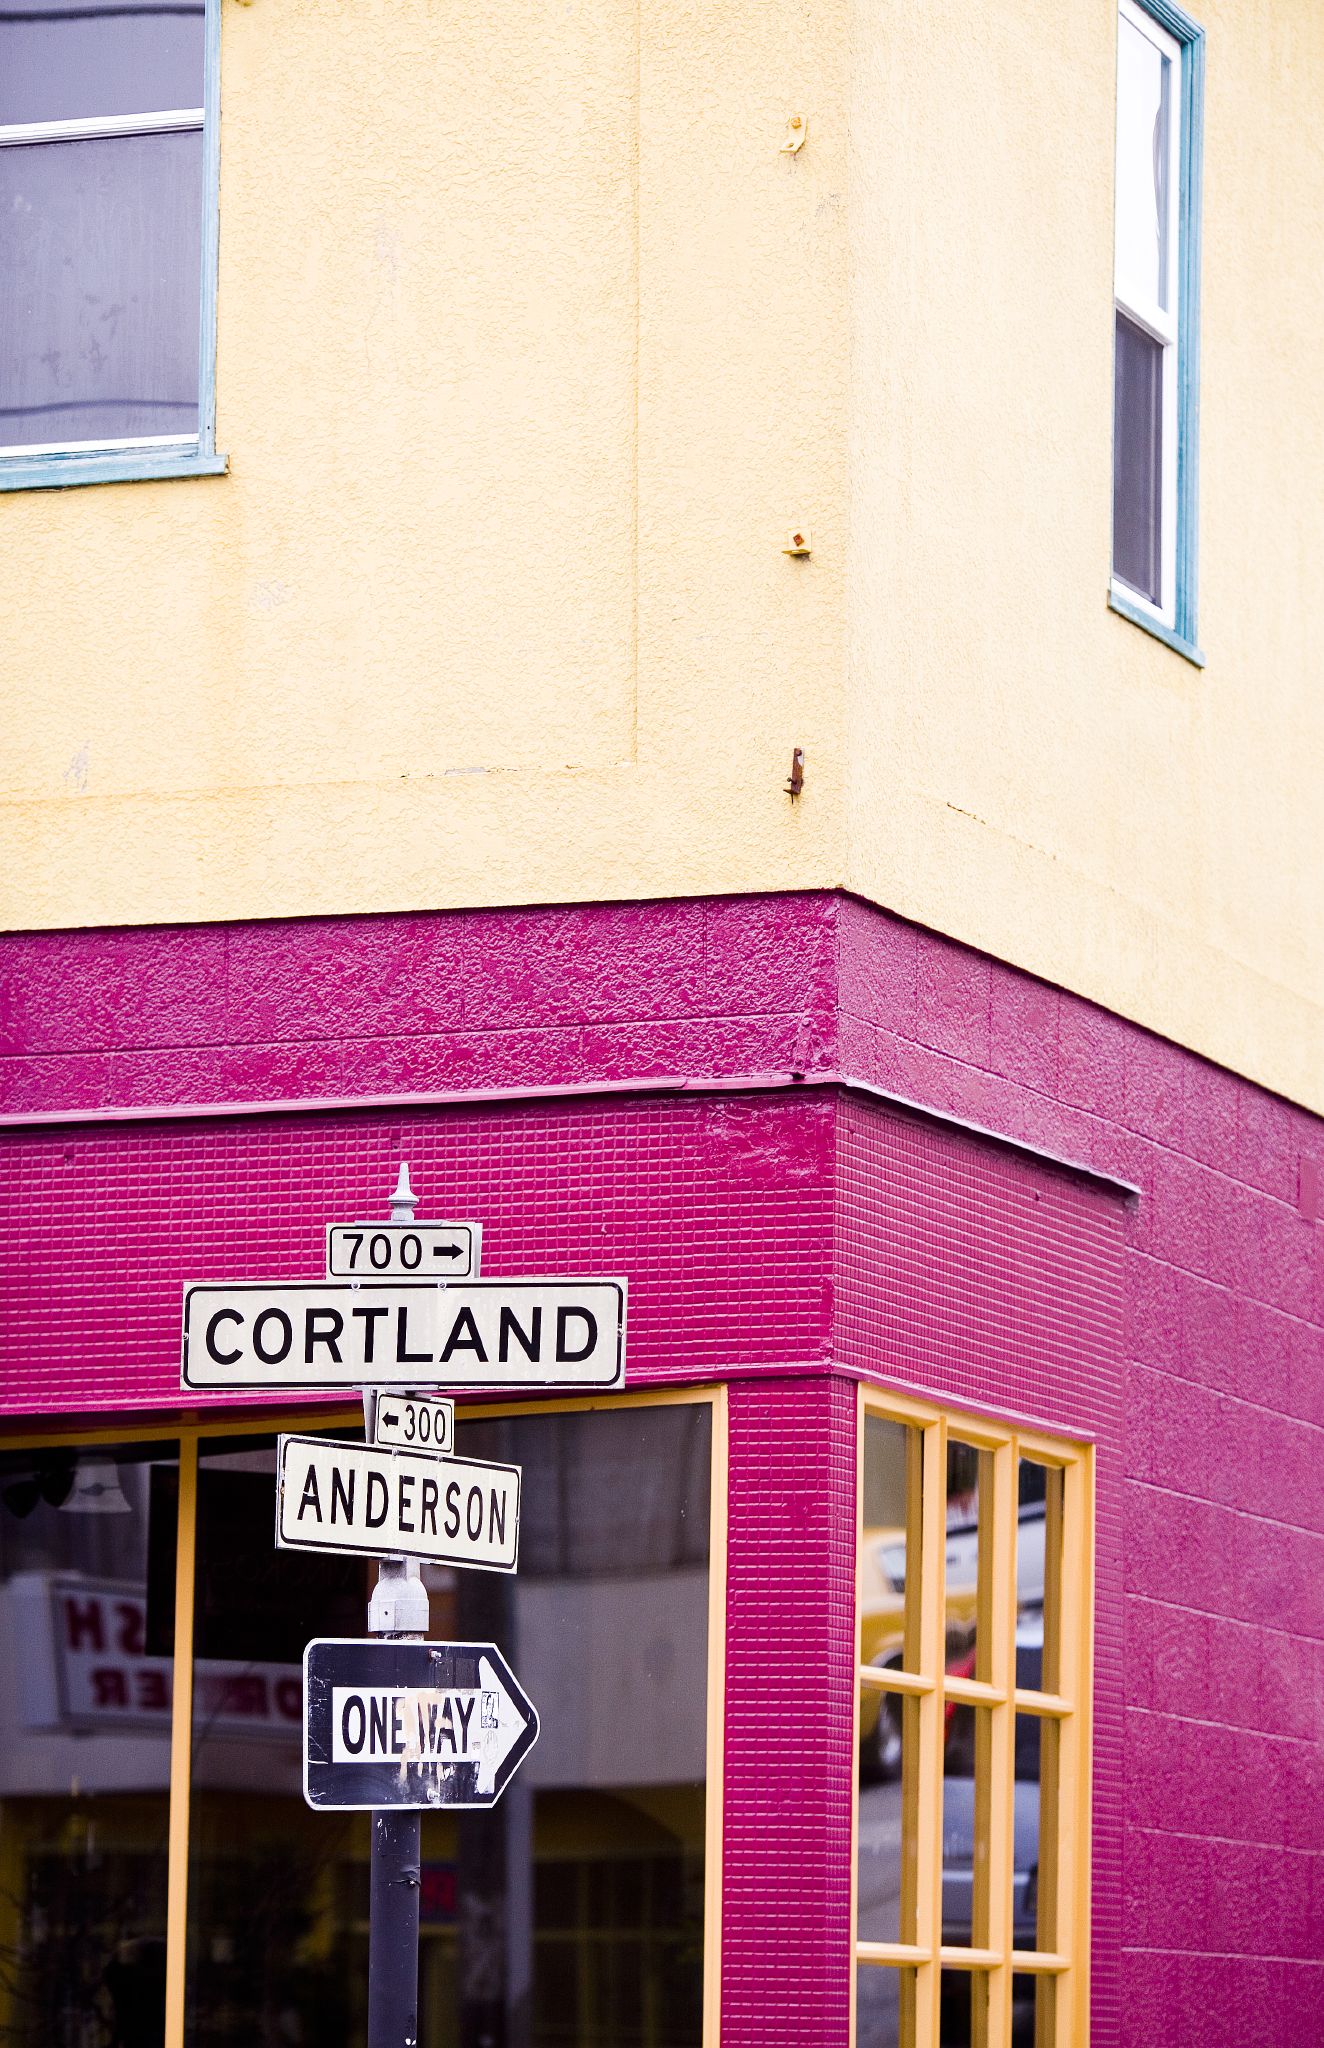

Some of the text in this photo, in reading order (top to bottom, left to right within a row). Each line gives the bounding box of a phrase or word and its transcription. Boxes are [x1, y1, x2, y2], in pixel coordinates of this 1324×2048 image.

[342, 1233, 423, 1270] 700
[205, 1306, 598, 1366] CORTLAND
[403, 1404, 446, 1444] 300
[297, 1464, 507, 1545] ANDERSON
[341, 1695, 475, 1755] ONE WAY
